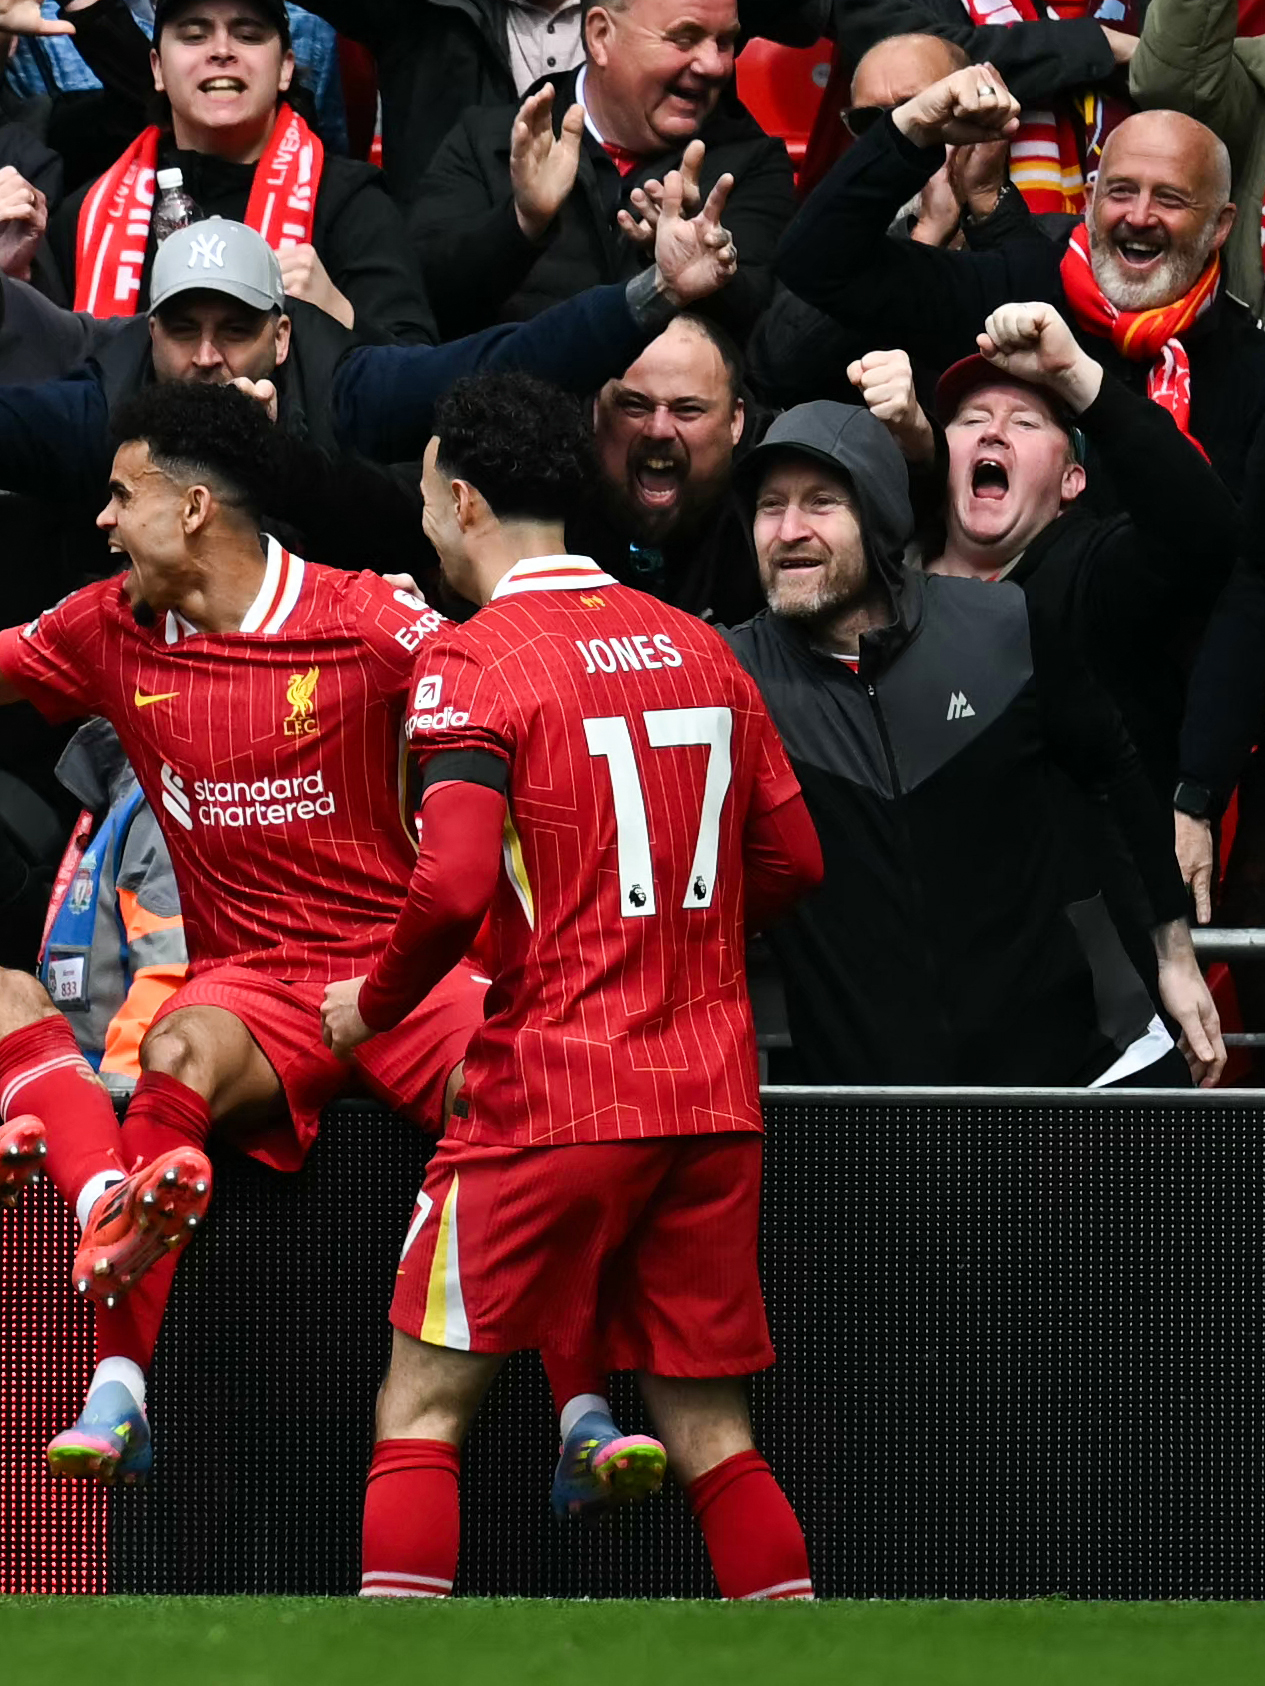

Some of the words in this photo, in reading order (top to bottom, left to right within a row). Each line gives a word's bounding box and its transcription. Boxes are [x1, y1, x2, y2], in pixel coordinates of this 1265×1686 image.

[575, 633, 683, 674] JONES
[194, 769, 324, 802] standard
[198, 791, 336, 827] chartered
[582, 706, 733, 918] 17
[61, 981, 77, 997] 833
